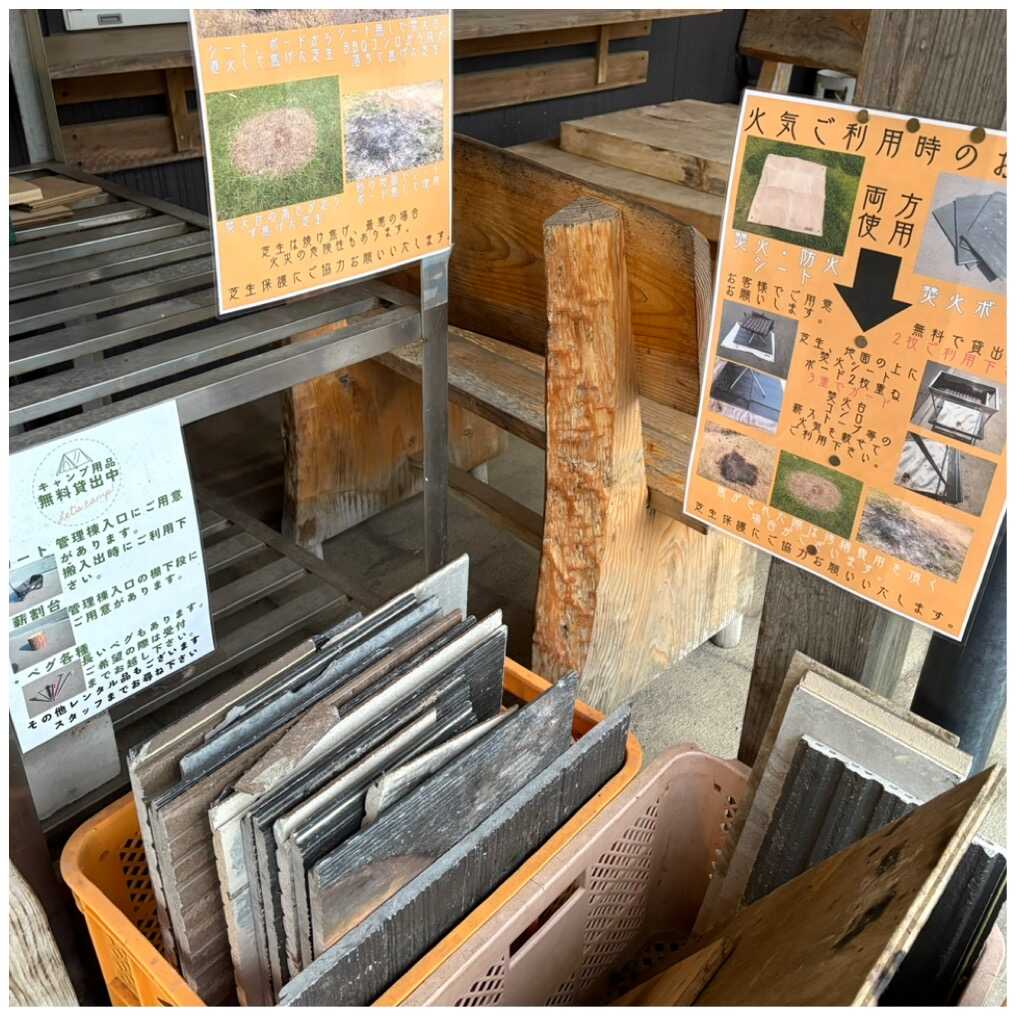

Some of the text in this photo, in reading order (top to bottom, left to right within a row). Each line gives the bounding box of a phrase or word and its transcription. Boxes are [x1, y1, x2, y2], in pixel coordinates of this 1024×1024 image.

[38, 457, 116, 492] キャンプ用品
[38, 468, 120, 509] 無料貸出中
[60, 527, 139, 564] があります。
[67, 574, 102, 591] さい。
[28, 635, 200, 730] その他レンタル品もございます
